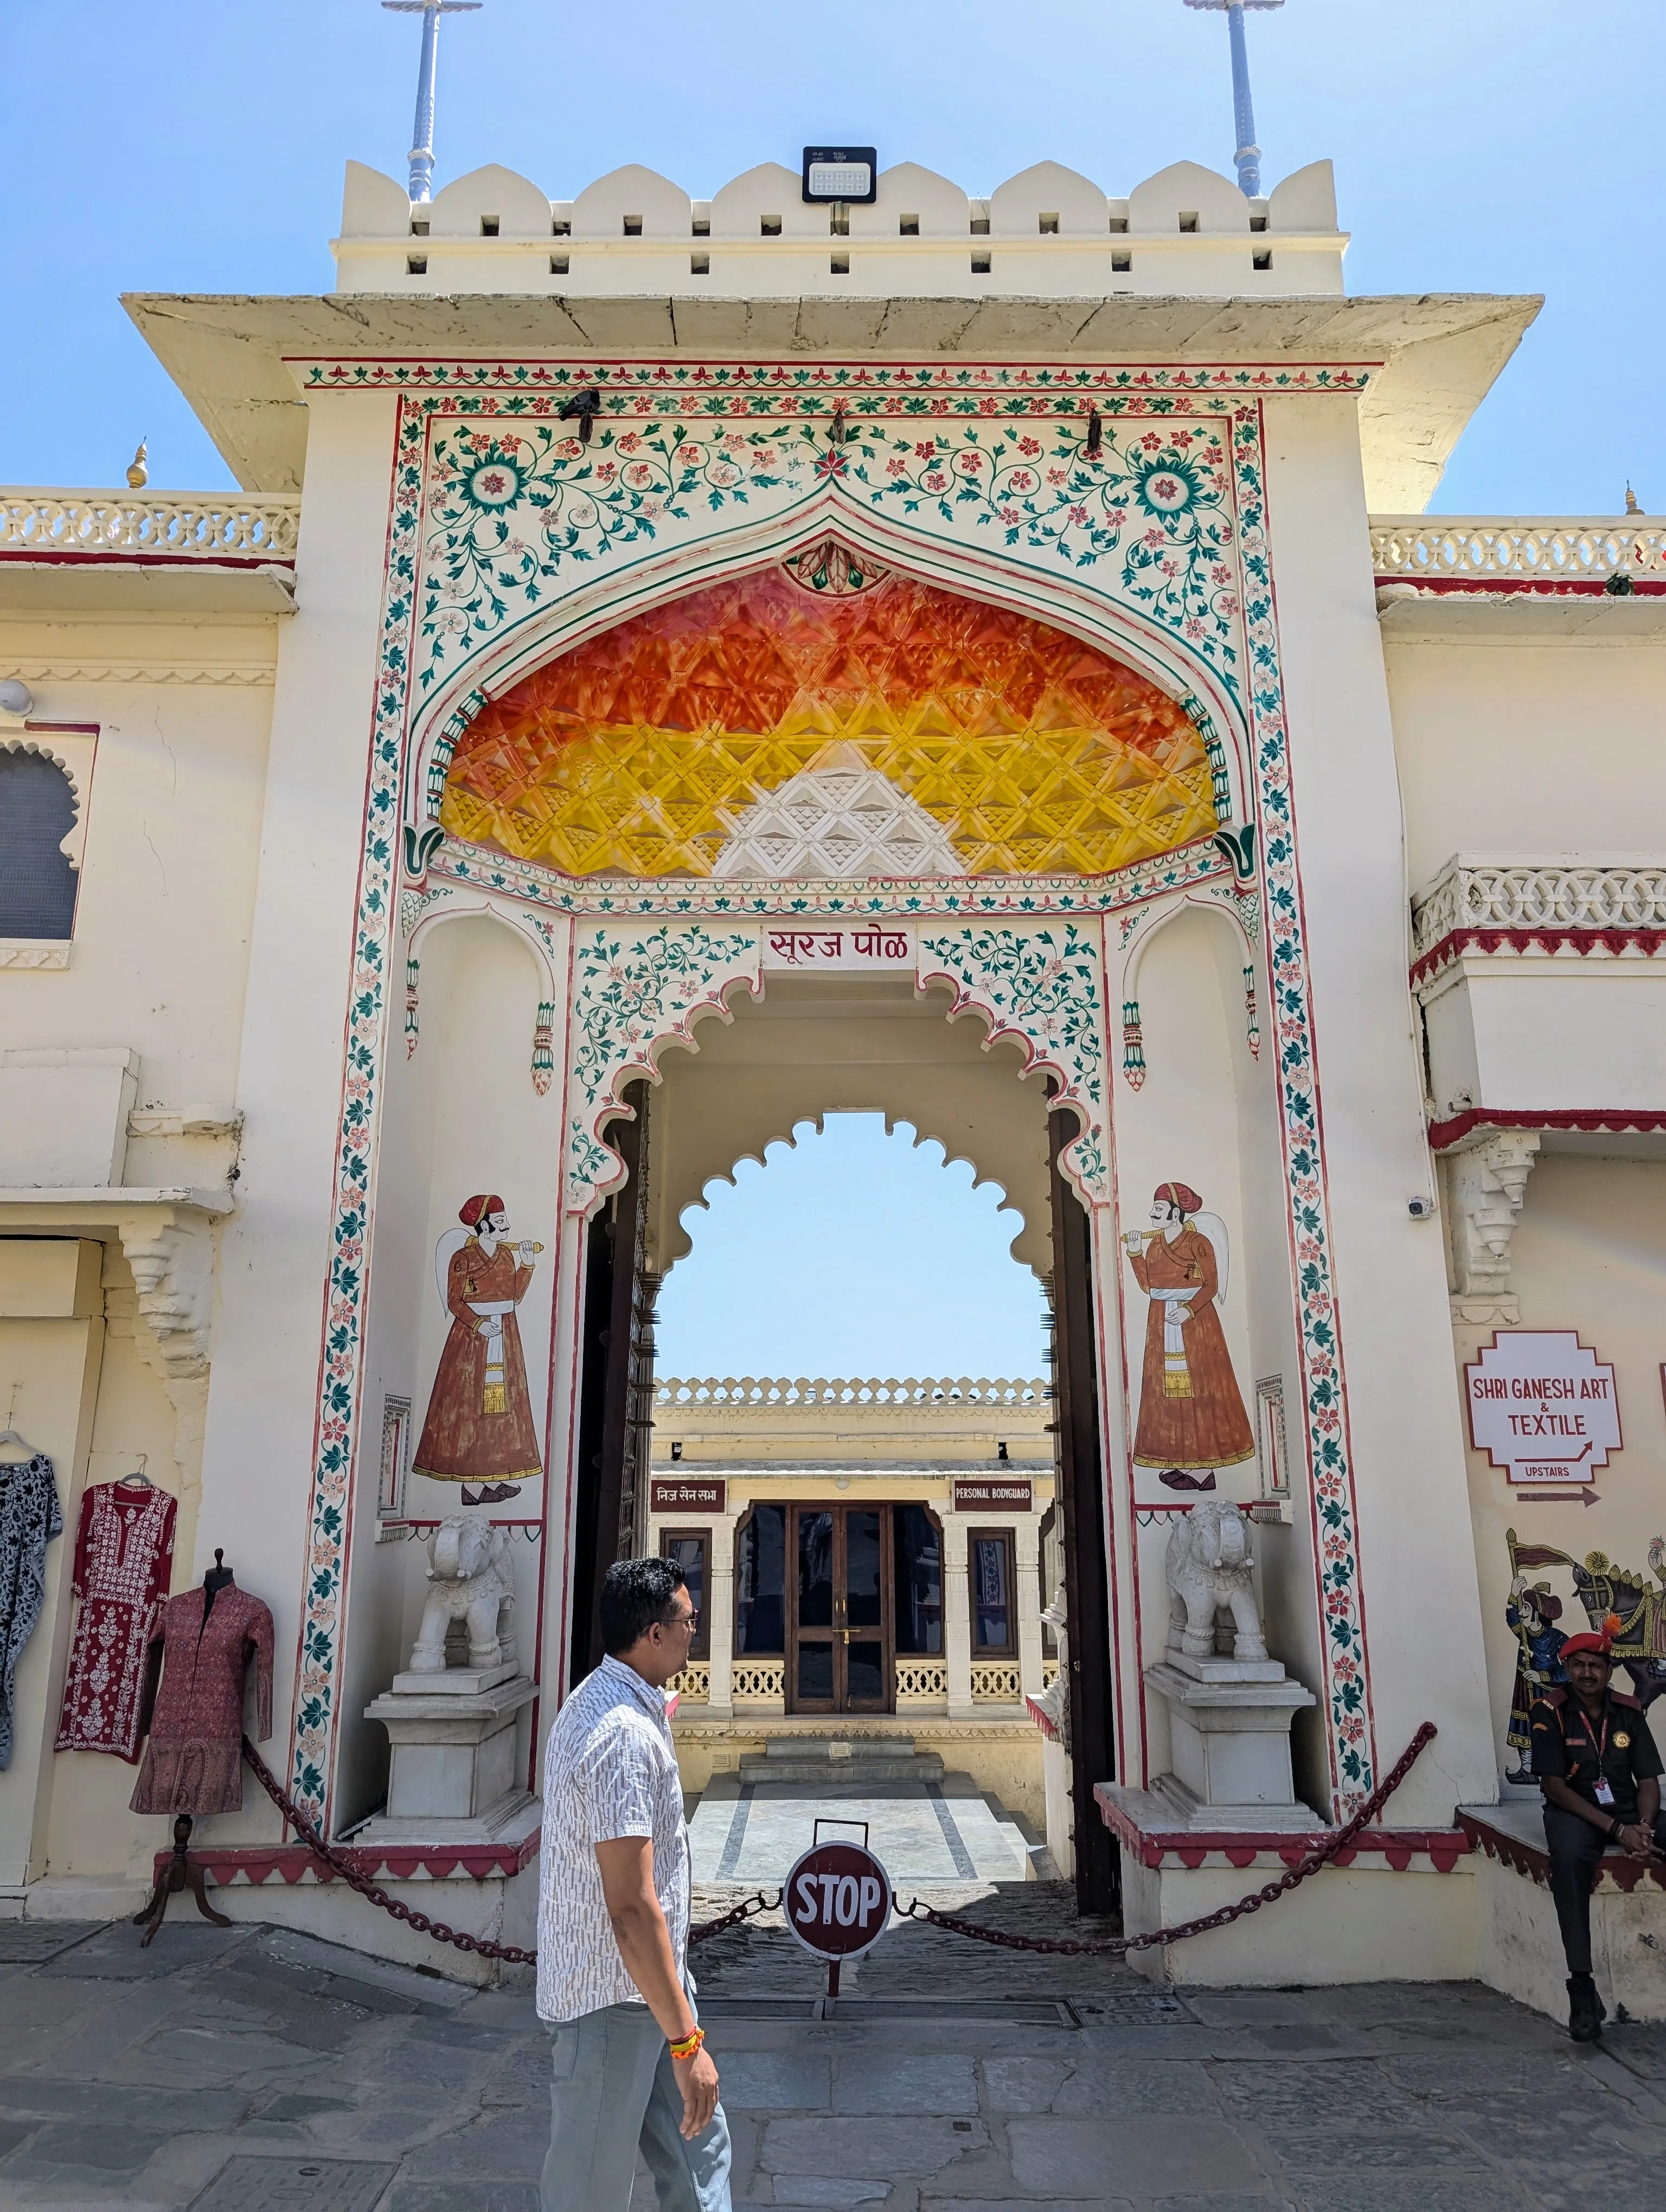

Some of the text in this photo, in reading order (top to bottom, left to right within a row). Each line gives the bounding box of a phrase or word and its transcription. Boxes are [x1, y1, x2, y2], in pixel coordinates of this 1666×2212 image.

[767, 923, 908, 964] सूरज पोळ
[1473, 1378, 1609, 1399] SHRI GANESH ART
[1540, 1402, 1549, 1412] &
[1508, 1414, 1587, 1436] TEXTILE
[1525, 1467, 1569, 1477] UPSTAIRS
[656, 1486, 717, 1501] निज सेन सभा
[956, 1488, 1030, 1499] PERSONAL BODYGUARD
[796, 1873, 881, 1927] STOP
